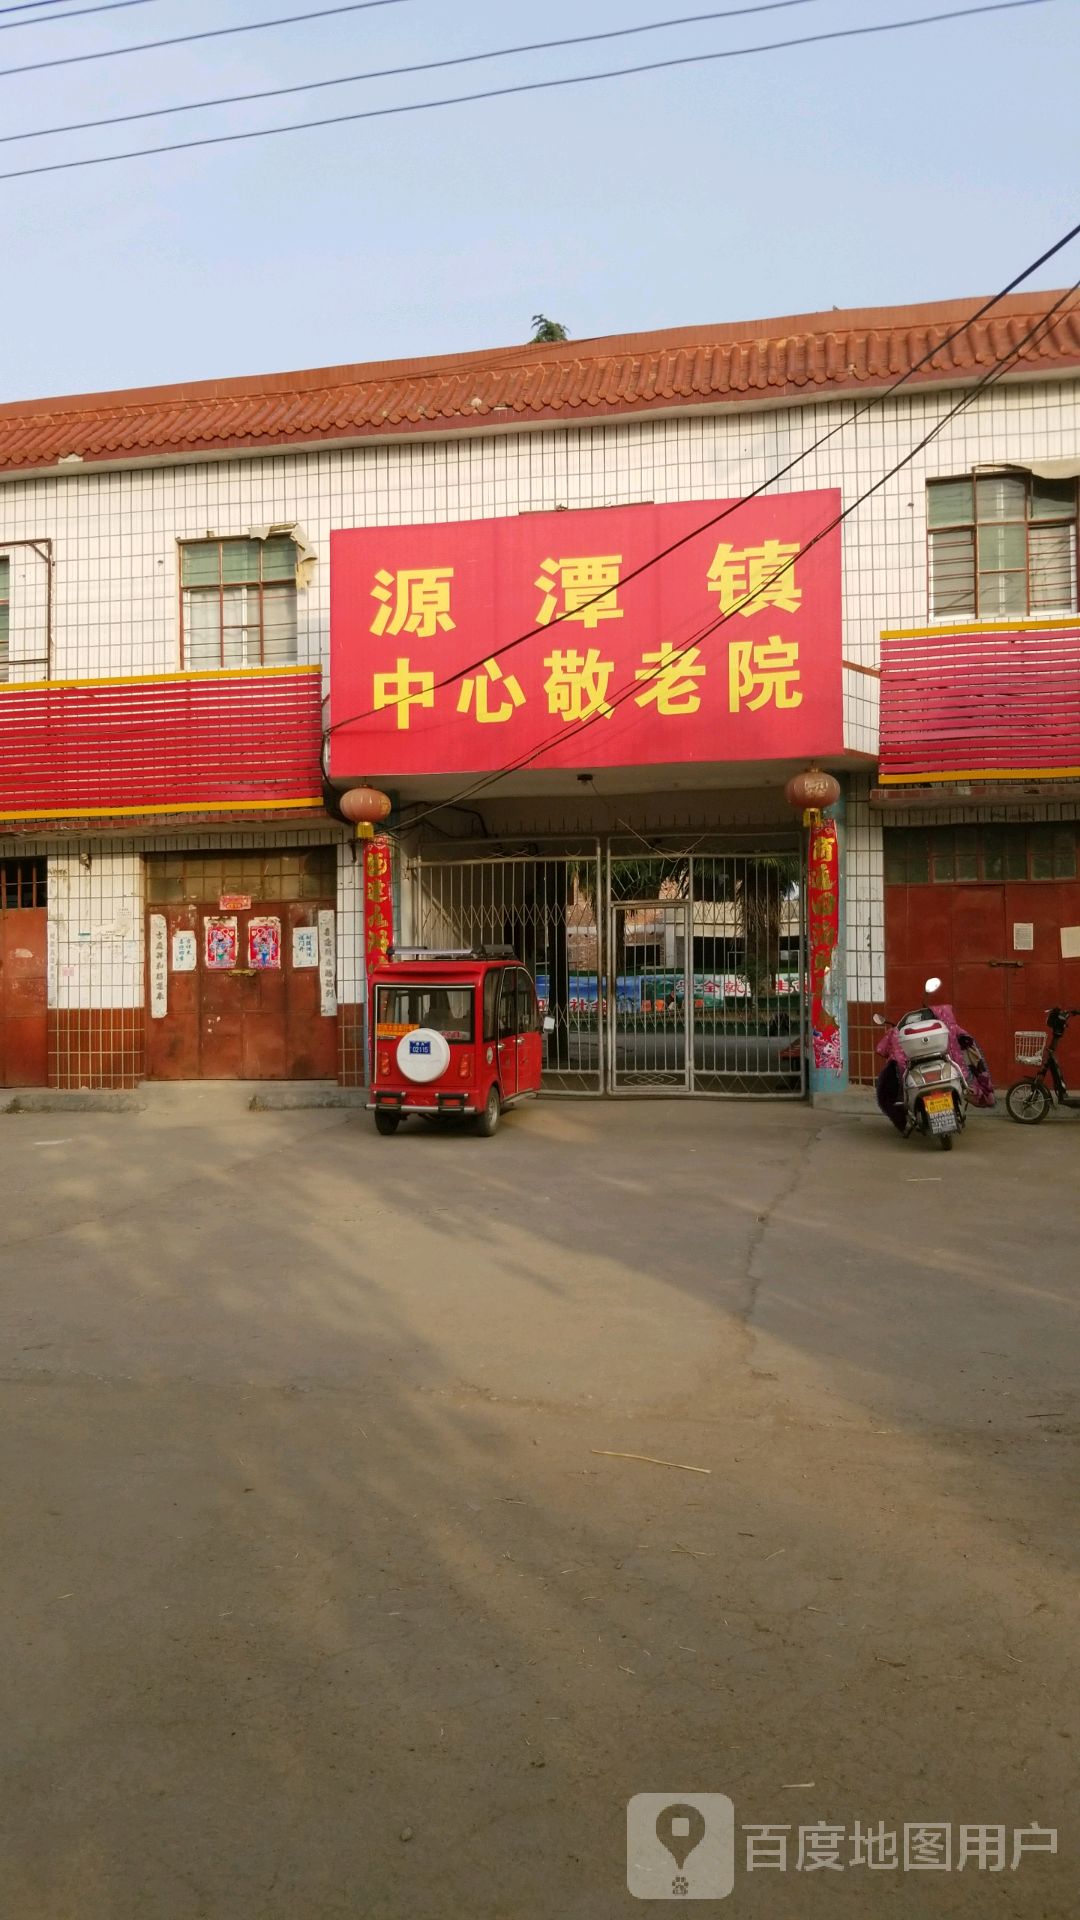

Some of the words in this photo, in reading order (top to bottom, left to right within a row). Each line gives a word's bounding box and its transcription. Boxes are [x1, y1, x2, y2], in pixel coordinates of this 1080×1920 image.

[369, 538, 803, 638] 源潭镇
[372, 635, 803, 730] 中心敬老院
